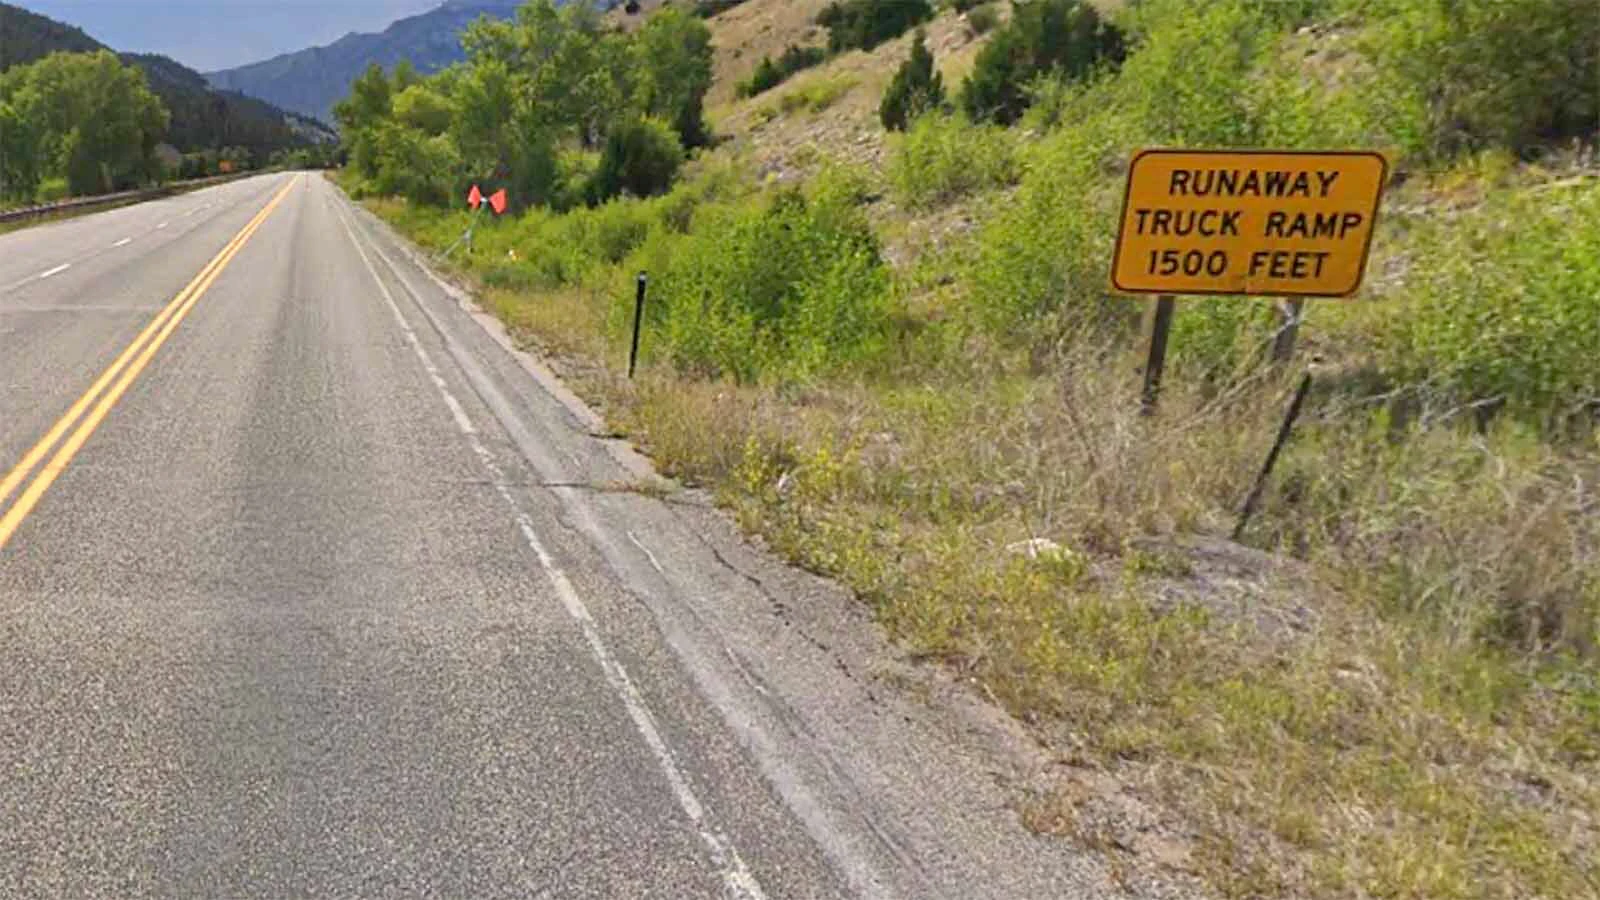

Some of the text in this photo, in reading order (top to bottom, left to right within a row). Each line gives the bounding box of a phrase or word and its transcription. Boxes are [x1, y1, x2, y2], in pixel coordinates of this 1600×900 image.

[1168, 169, 1340, 198] RUNAWAY
[1135, 208, 1362, 241] TRUCK RAMP
[1148, 248, 1330, 279] 1500 FEET
